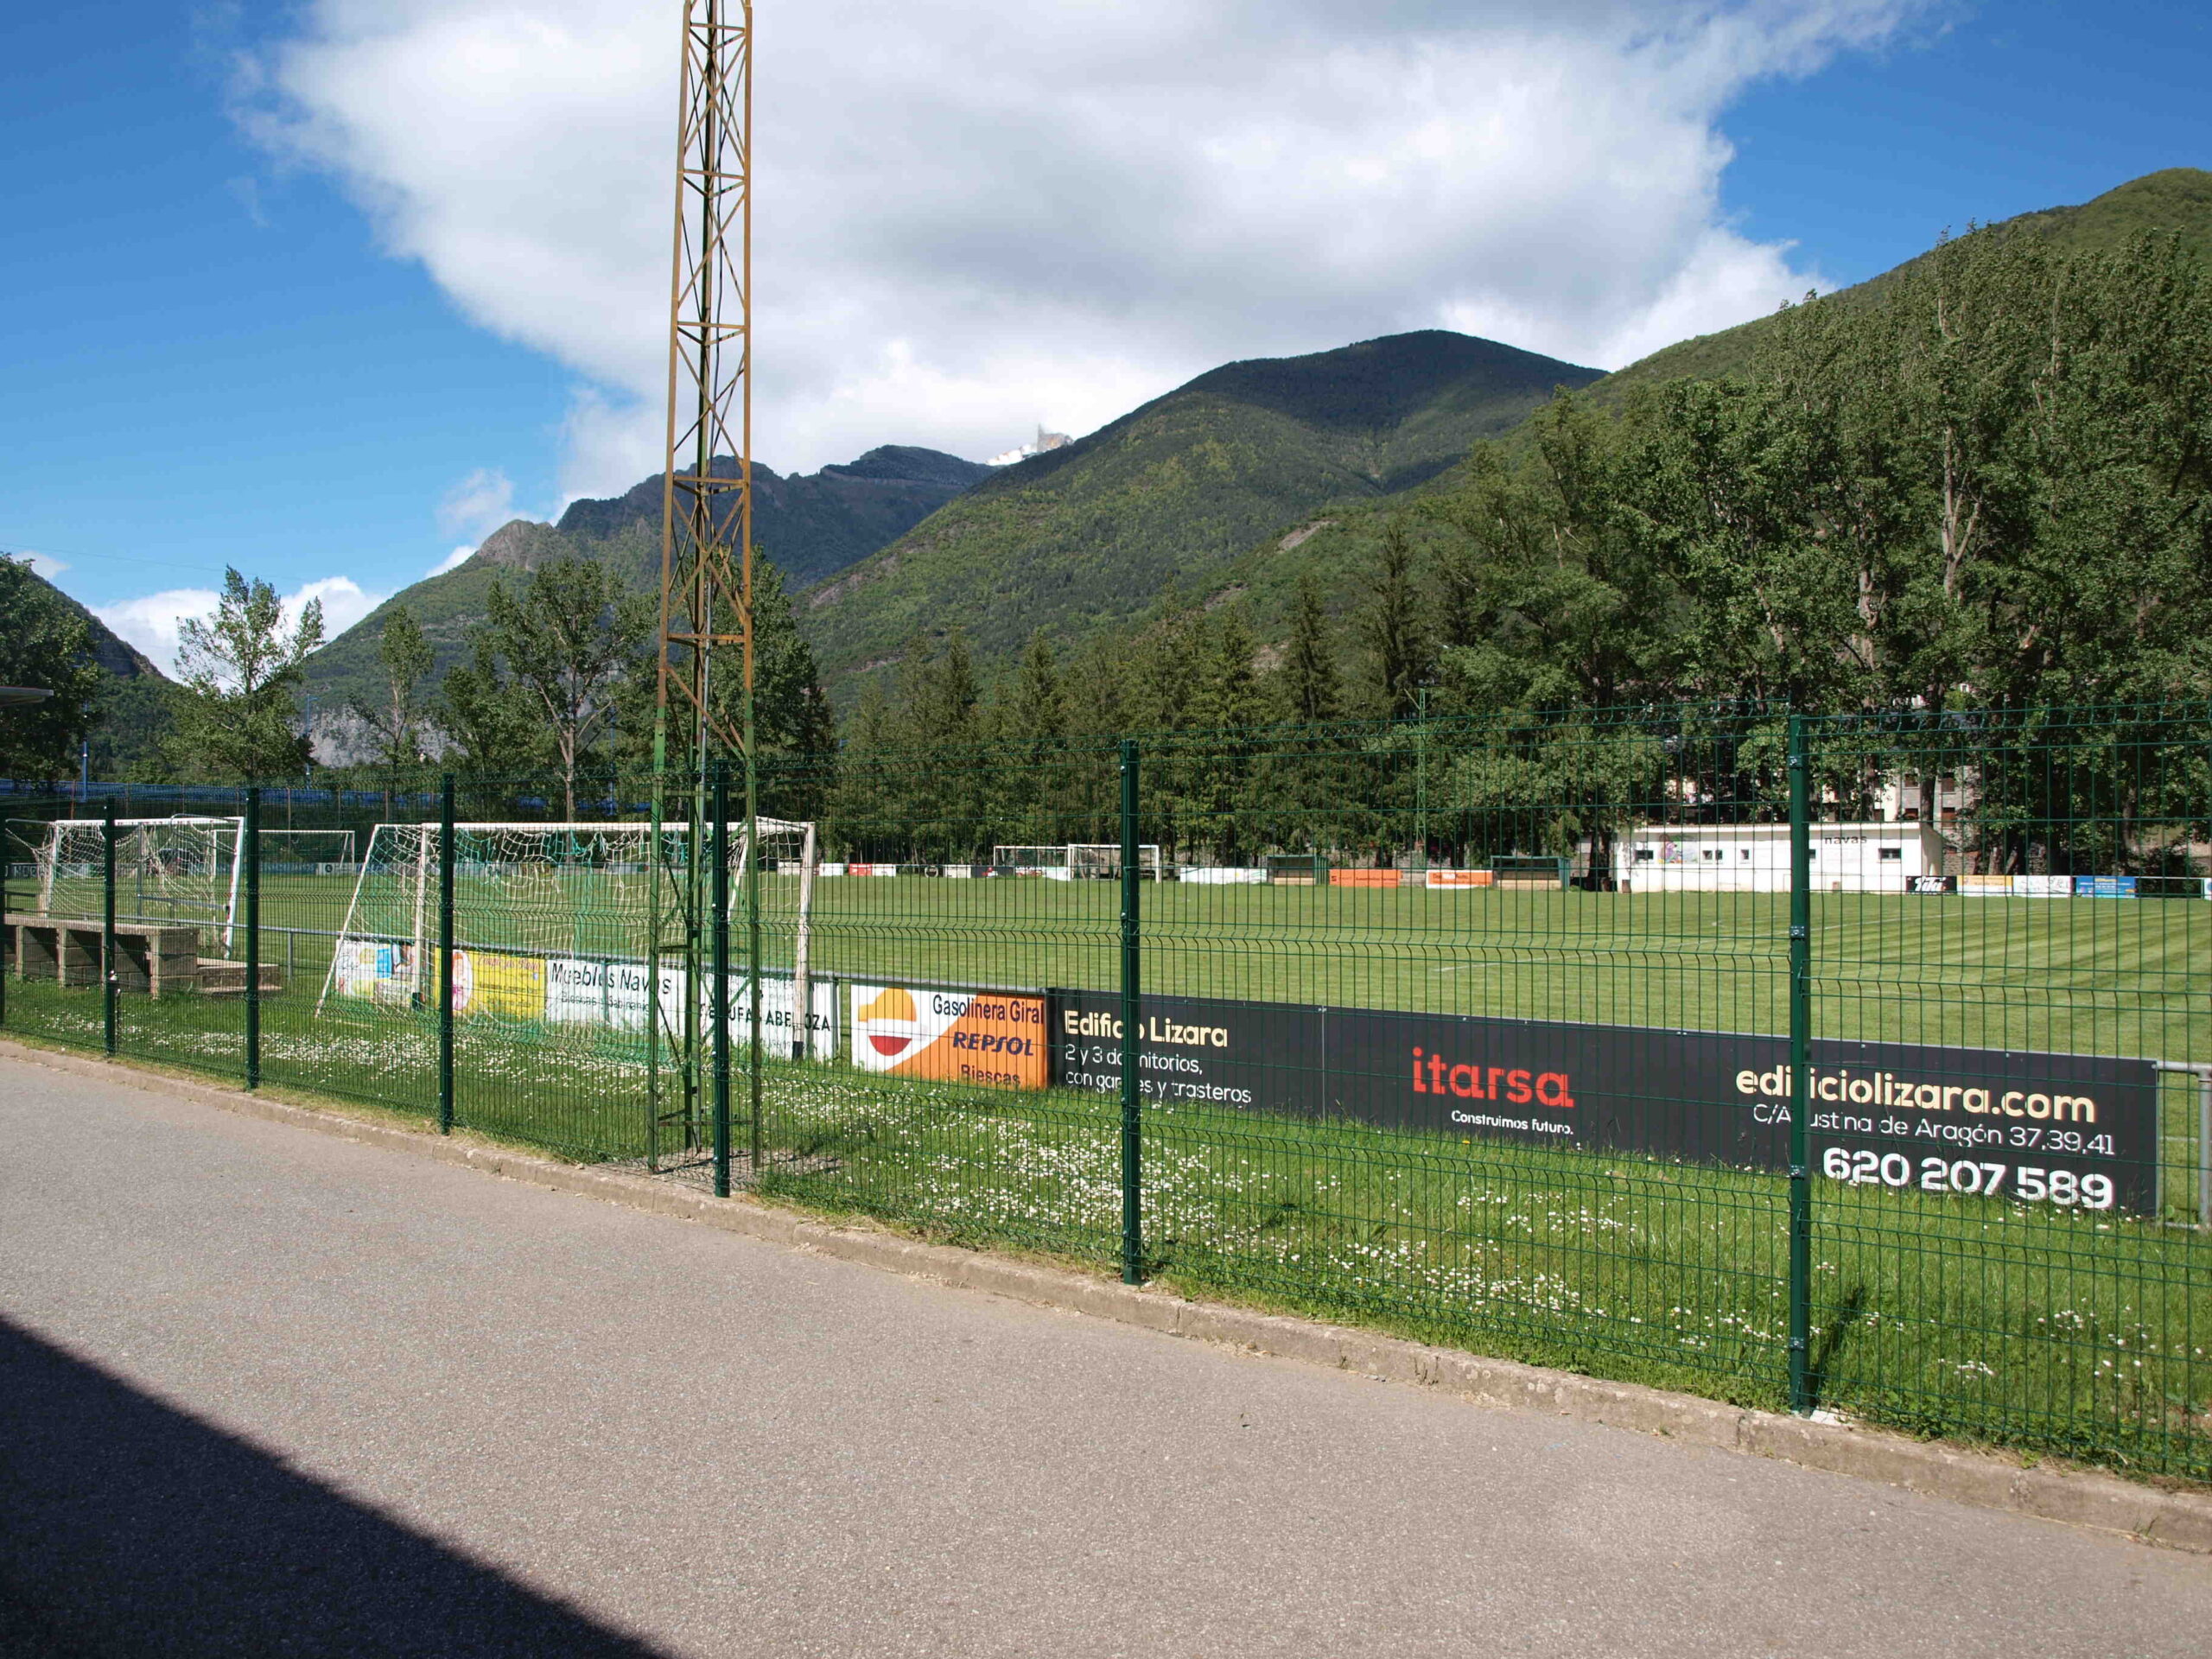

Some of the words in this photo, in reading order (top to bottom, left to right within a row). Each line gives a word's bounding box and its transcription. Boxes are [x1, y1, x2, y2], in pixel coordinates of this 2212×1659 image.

[620, 969, 671, 995] Navs
[933, 994, 1006, 1021] Gasolinera
[1010, 1000, 1044, 1025] Giral
[953, 1031, 1033, 1057] REPSOL
[1065, 1009, 1145, 1040] Edific
[1150, 1017, 1228, 1047] Lizara
[1065, 1044, 1076, 1061] 2
[1079, 1050, 1089, 1066] y
[1092, 1046, 1103, 1064] 3
[1065, 1071, 1093, 1087] con
[1157, 1081, 1167, 1099] y
[1172, 1082, 1252, 1103] trasteros
[1412, 1046, 1575, 1108] itarsa
[1735, 1065, 2096, 1123] ediiciolizara.com
[1451, 1109, 1529, 1131] Construimos
[1532, 1118, 1574, 1135] futuro.
[1753, 1103, 1872, 1133] C/Austina
[1880, 1115, 1909, 1138] de
[1915, 1118, 2003, 1148] Aragón
[2010, 1127, 2115, 1156] 37,39,41
[1822, 1147, 1910, 1188] 620
[1921, 1157, 2006, 1196] 207
[2017, 1166, 2114, 1210] 589
